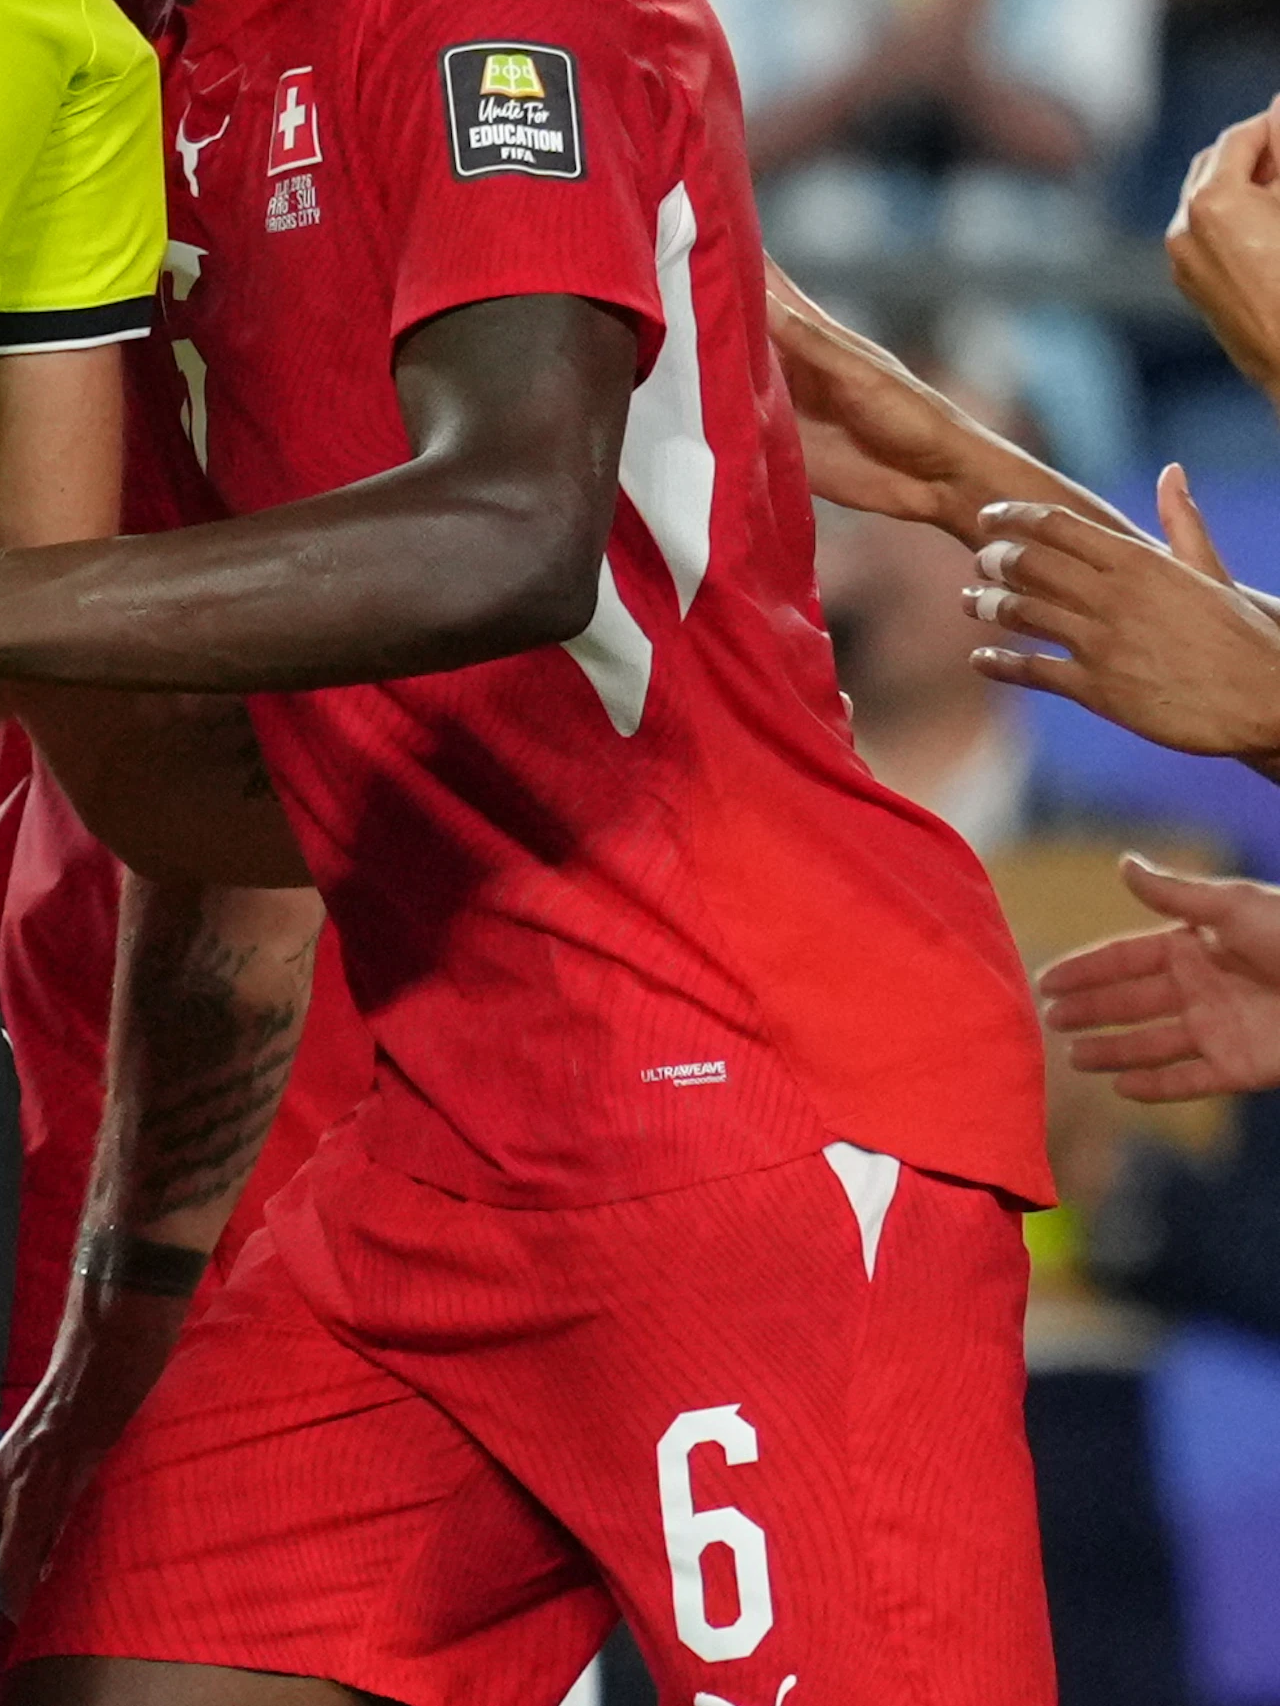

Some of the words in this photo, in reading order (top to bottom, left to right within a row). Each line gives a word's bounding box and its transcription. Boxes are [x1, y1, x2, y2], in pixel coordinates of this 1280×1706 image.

[478, 96, 524, 124] Unite
[523, 101, 550, 125] For
[468, 123, 564, 153] EDUCATION
[500, 146, 537, 164] FIFA
[296, 186, 316, 210] SUI
[640, 1061, 726, 1083] ULTRAWEAVE
[656, 1403, 773, 1663] 6
